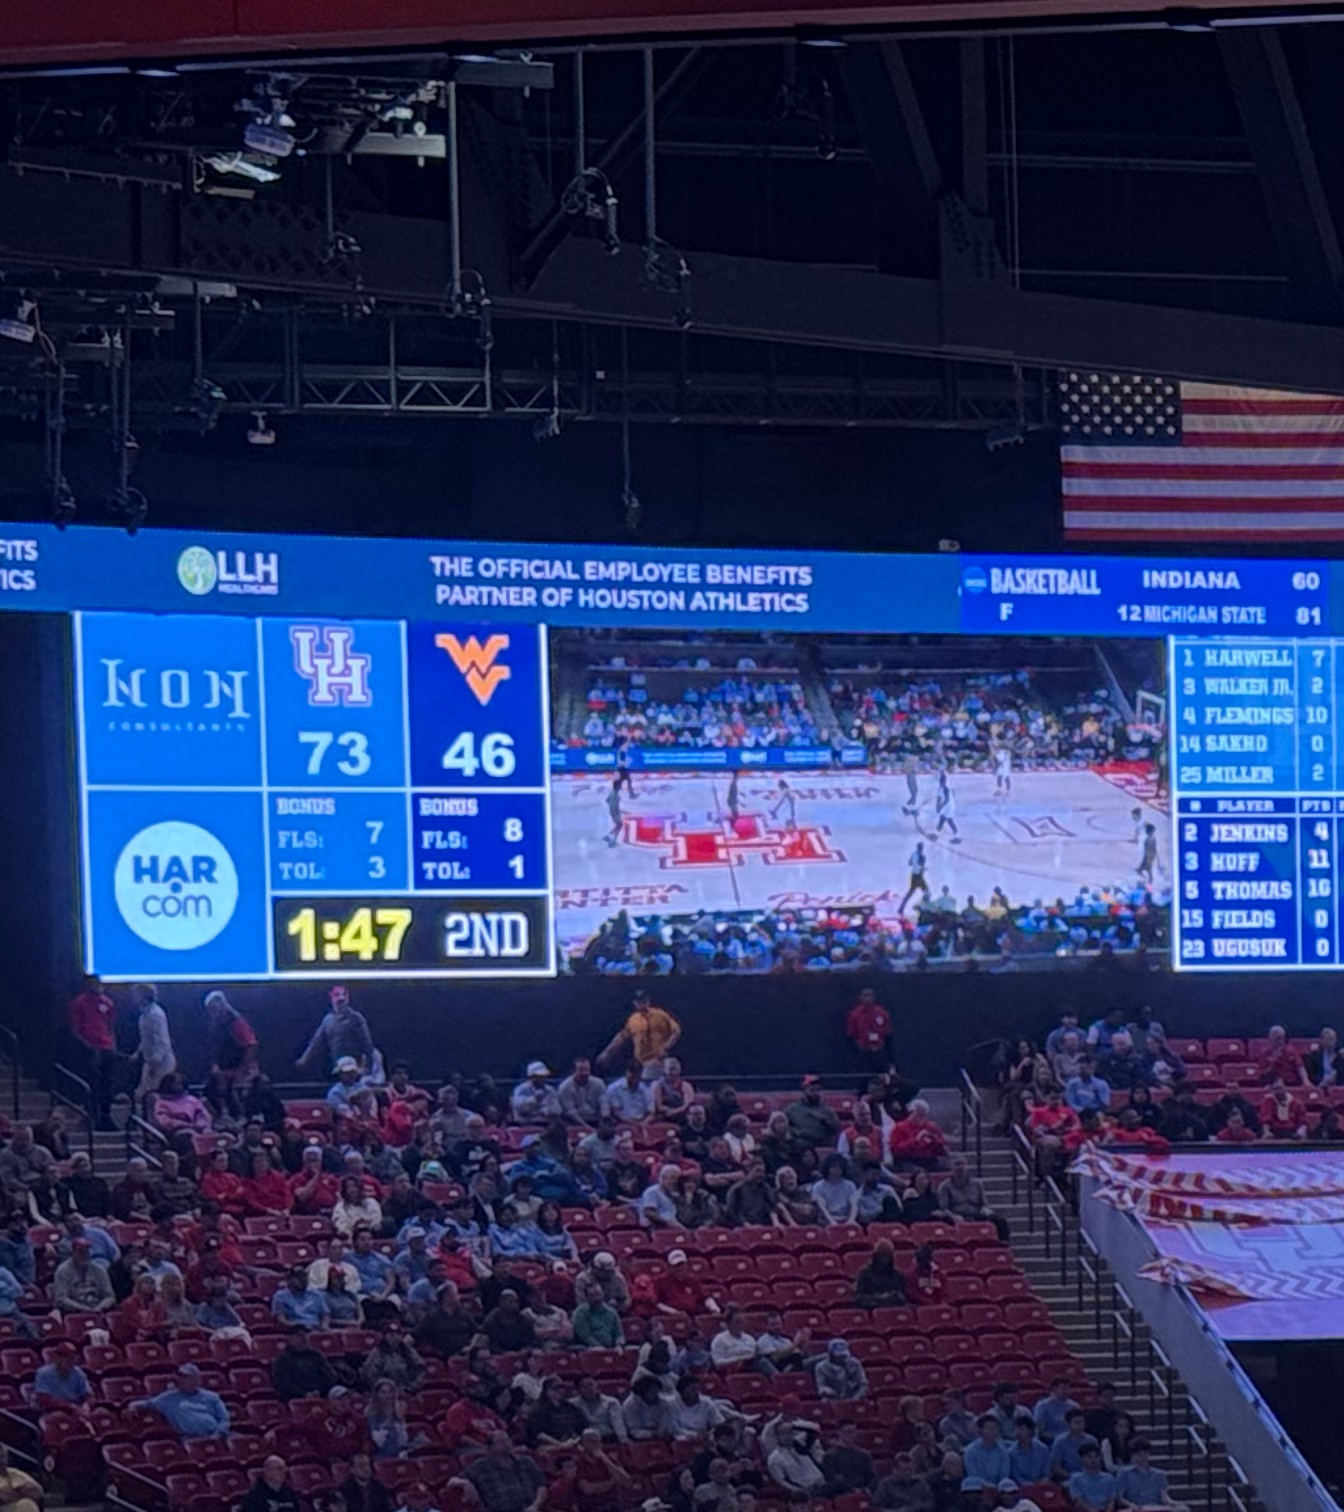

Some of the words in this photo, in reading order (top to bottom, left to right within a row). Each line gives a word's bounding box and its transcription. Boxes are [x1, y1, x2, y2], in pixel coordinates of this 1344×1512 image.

[217, 551, 279, 583] LLH
[430, 556, 474, 578] THE
[478, 558, 580, 581] OFFICIAL
[584, 561, 700, 584] EMPLOYEE
[706, 565, 813, 586] BENEFITS
[991, 568, 1101, 595] BASKETBALL
[1143, 571, 1240, 589] INDIANA
[1292, 572, 1320, 590] 60
[436, 585, 537, 607] PARTNER
[542, 586, 573, 608] OF
[578, 588, 685, 611] HOUSTON
[689, 591, 810, 613] ATHLETICS
[1000, 603, 1014, 621] F
[1116, 605, 1142, 622] 12
[1143, 605, 1218, 624] MICHIGAN
[1222, 607, 1266, 625] STATE
[1296, 607, 1322, 625] 81
[1184, 650, 1194, 666] 1
[1204, 649, 1293, 667] HARWELL
[1311, 651, 1325, 667] 7
[1184, 678, 1196, 695] 3
[1204, 678, 1268, 696] WALKER
[1311, 677, 1323, 694] 2
[1184, 707, 1196, 724] 4
[1204, 706, 1294, 725] FLEMINGS
[1306, 706, 1328, 724] 10
[1180, 736, 1201, 752] 14
[1311, 735, 1324, 752] 0
[299, 732, 371, 776] 73
[442, 733, 516, 776] 46
[1180, 767, 1202, 784] 25
[1204, 766, 1275, 784] MILLER
[1312, 764, 1324, 782] 2
[276, 798, 336, 815] BONUS
[420, 798, 478, 816] BONUS
[366, 821, 384, 844] 7
[504, 819, 523, 842] 8
[1184, 823, 1198, 842] 2
[1210, 824, 1289, 842] JENKINS
[1314, 822, 1329, 840] 4
[132, 856, 218, 884] HAR
[368, 857, 386, 879] 3
[508, 856, 525, 880] 1
[1184, 852, 1198, 871] 3
[1210, 853, 1260, 872] HUFF
[1308, 850, 1330, 869] 11
[1185, 881, 1199, 899] 5
[1211, 881, 1293, 900] THOMAS
[1182, 909, 1203, 928] 15
[1211, 910, 1276, 929] FIELDS
[1315, 910, 1328, 928] 0
[287, 909, 413, 962] 1:47
[444, 912, 529, 957] 2ND
[1183, 939, 1204, 958] 23
[1316, 938, 1329, 957] 0
